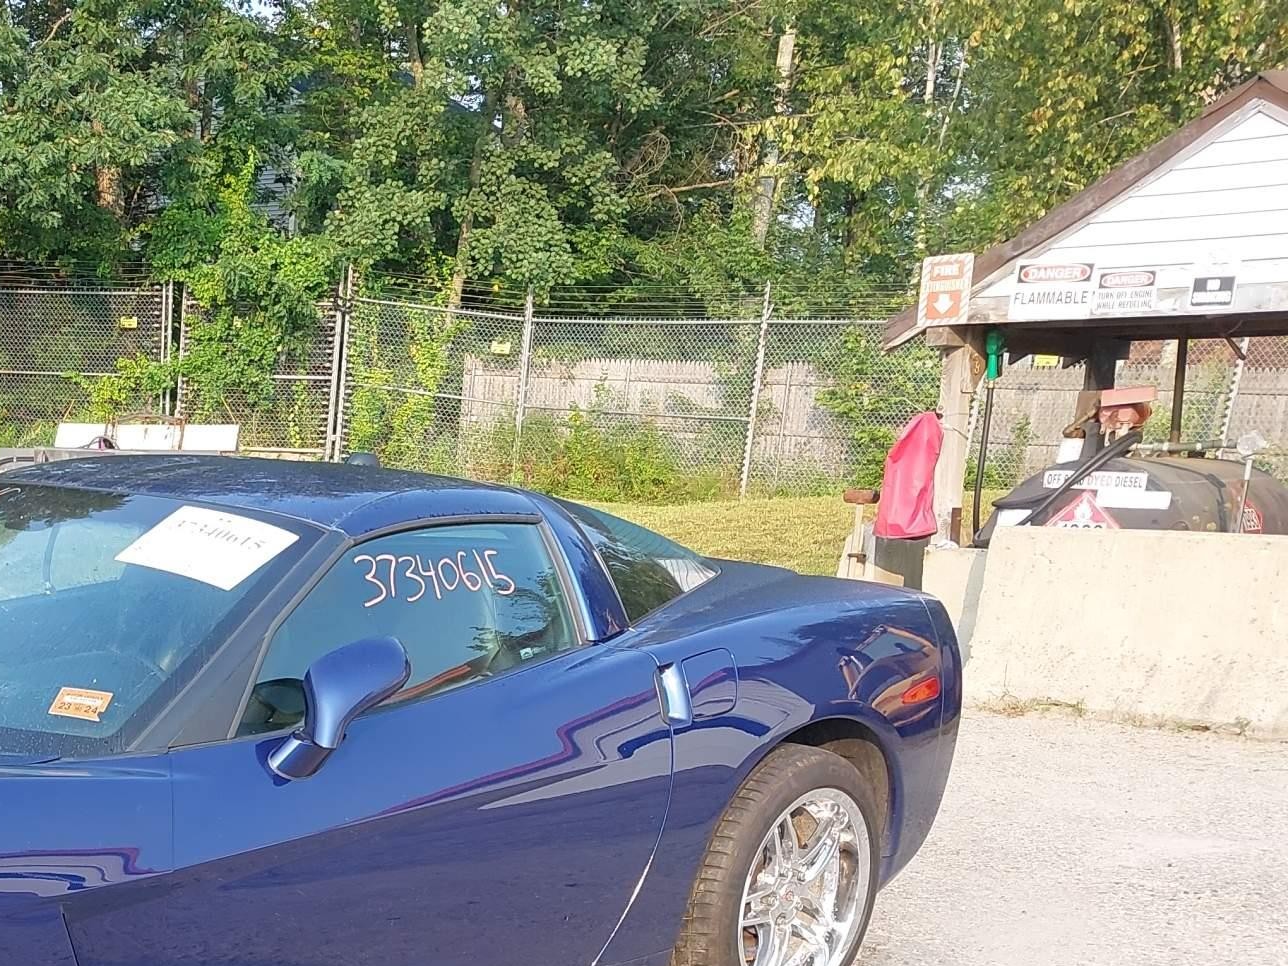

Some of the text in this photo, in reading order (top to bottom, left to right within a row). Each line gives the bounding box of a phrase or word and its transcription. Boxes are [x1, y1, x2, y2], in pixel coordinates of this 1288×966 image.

[1029, 267, 1082, 280] DANGER
[1107, 274, 1148, 285] DANGER
[1013, 291, 1089, 305] FLAMMABLE
[1098, 290, 1152, 299] TURN OFF ENGINE
[1096, 301, 1115, 310] WHILE
[1047, 473, 1063, 485] OFF
[1087, 475, 1112, 487] DYED
[1114, 477, 1143, 488] DIESEL
[354, 549, 515, 607] 37340615
[58, 702, 72, 711] 23
[84, 705, 98, 714] 24
